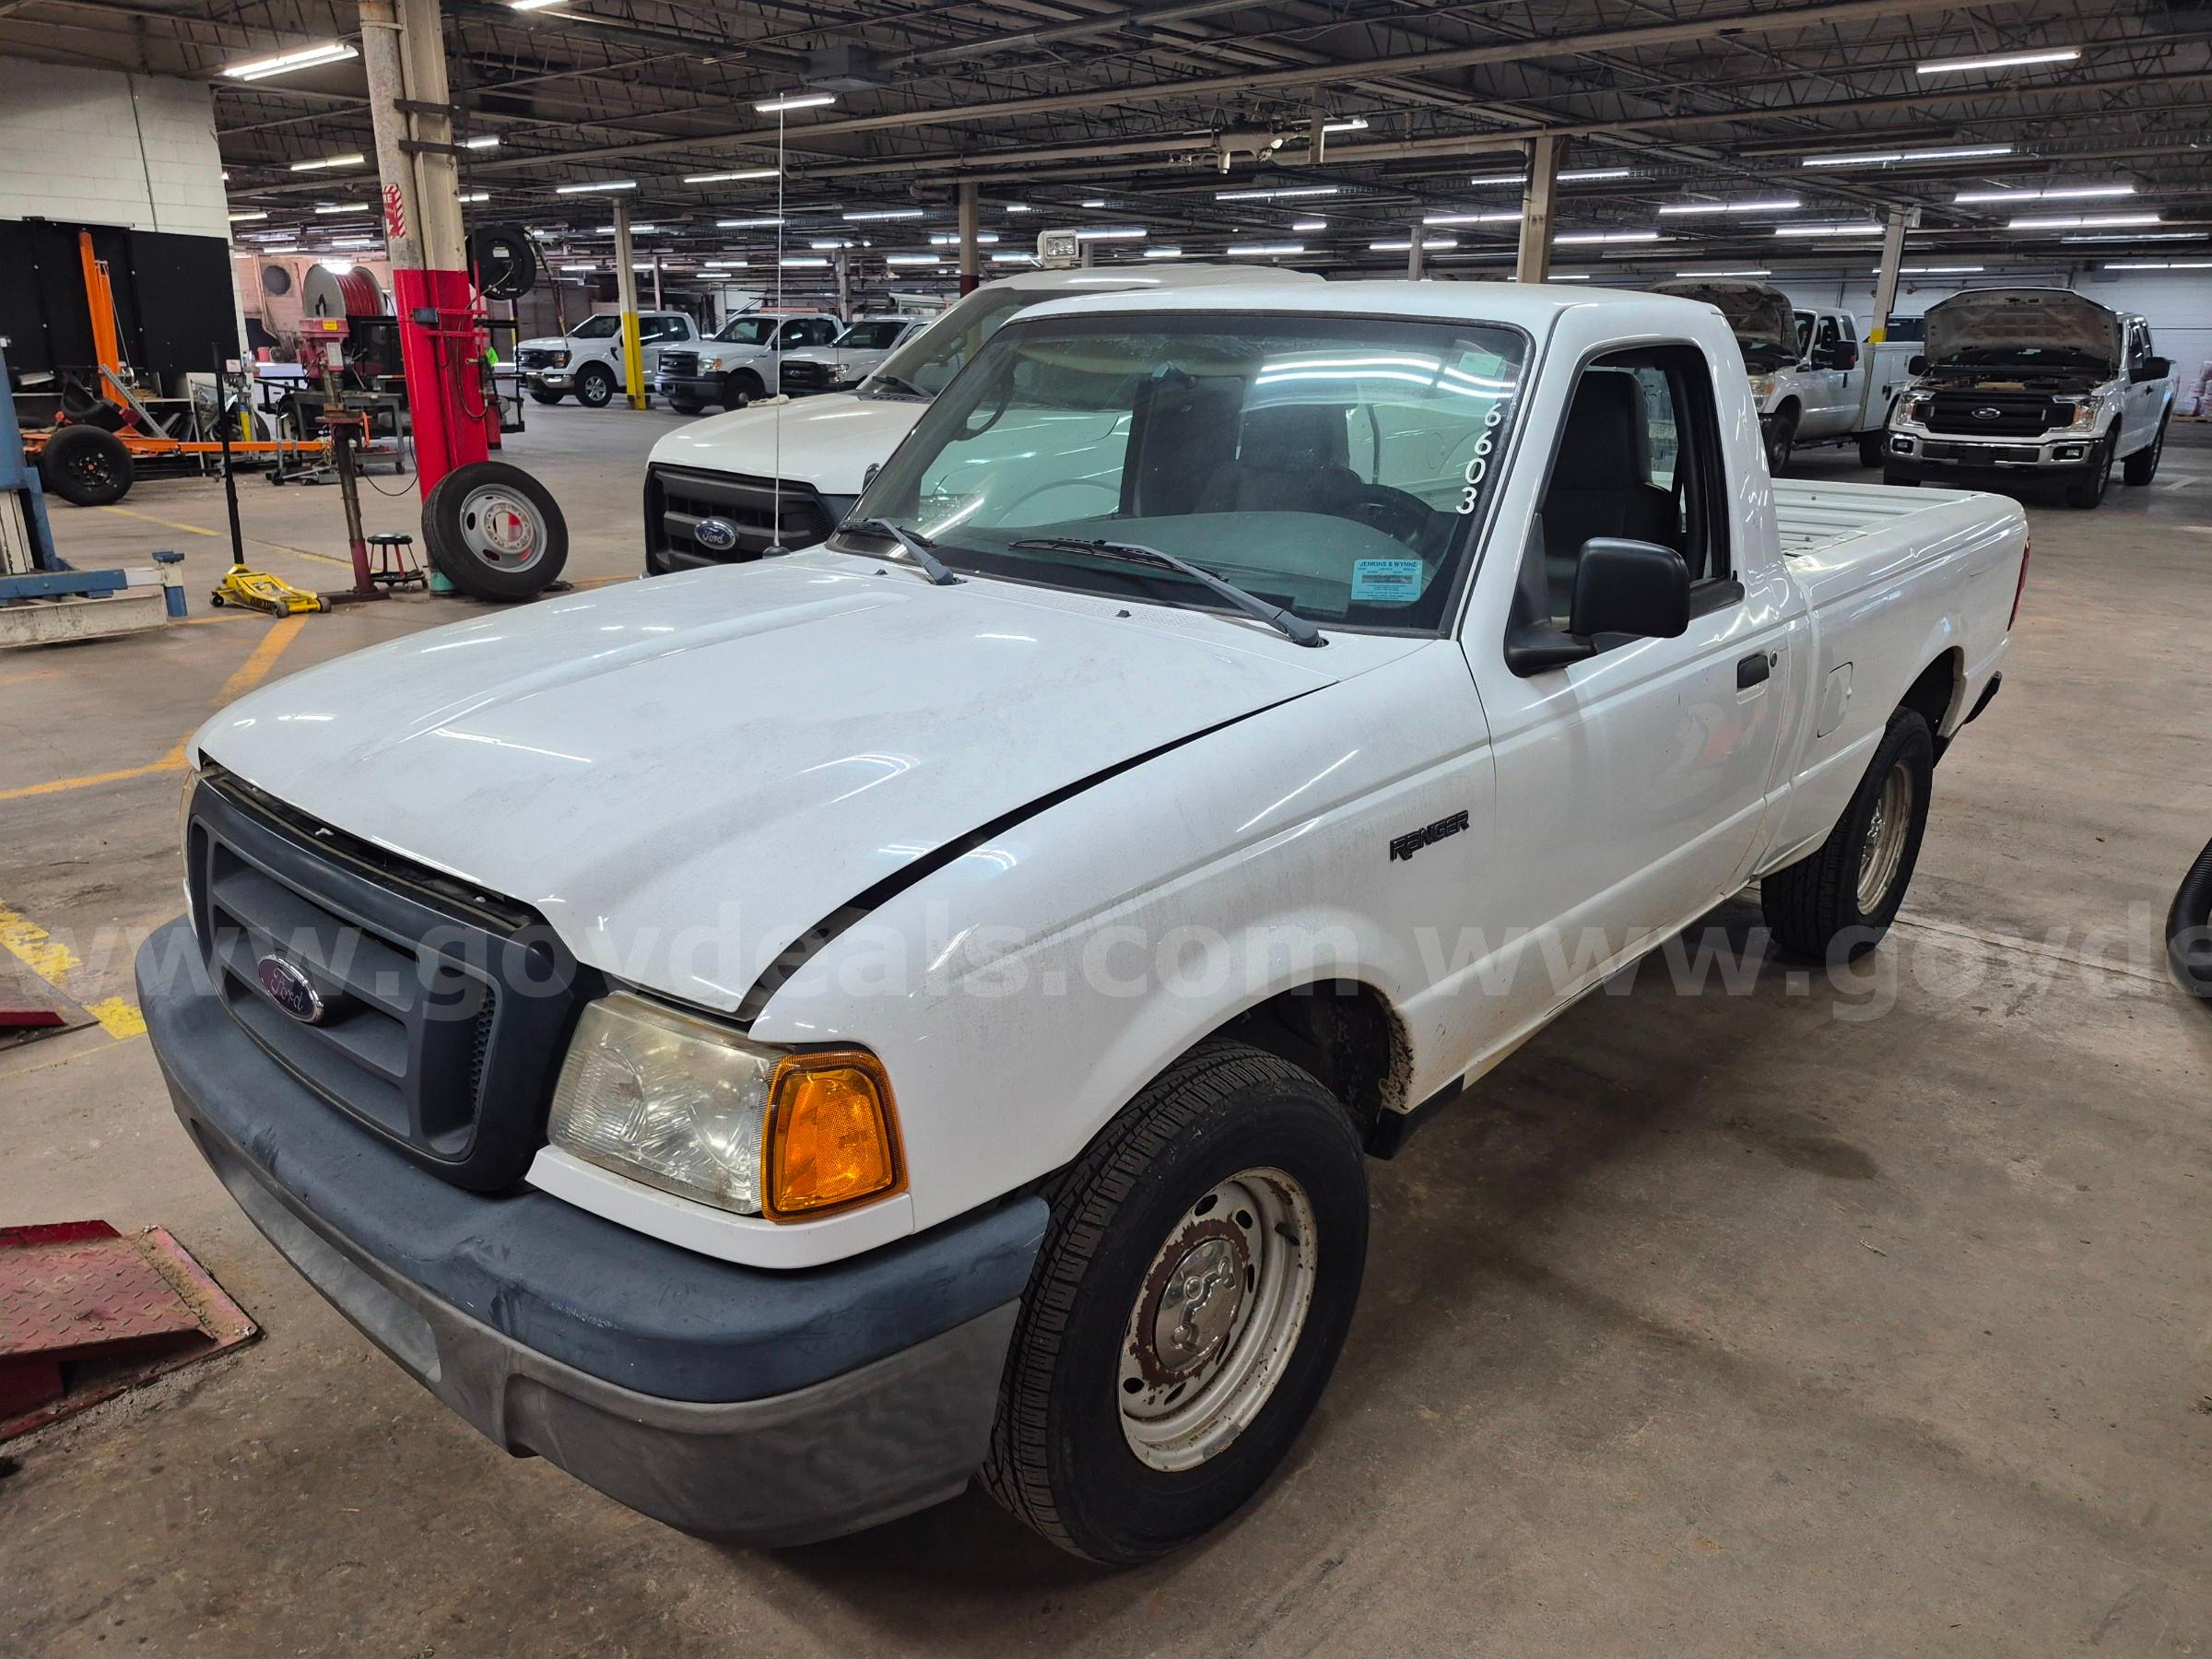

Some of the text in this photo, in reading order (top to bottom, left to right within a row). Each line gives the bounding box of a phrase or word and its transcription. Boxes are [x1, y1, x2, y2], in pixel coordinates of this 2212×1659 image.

[1455, 403, 1502, 515] 6603
[702, 526, 724, 545] Ford
[1389, 809, 1470, 862] RANGER
[270, 967, 303, 1011] Ford
